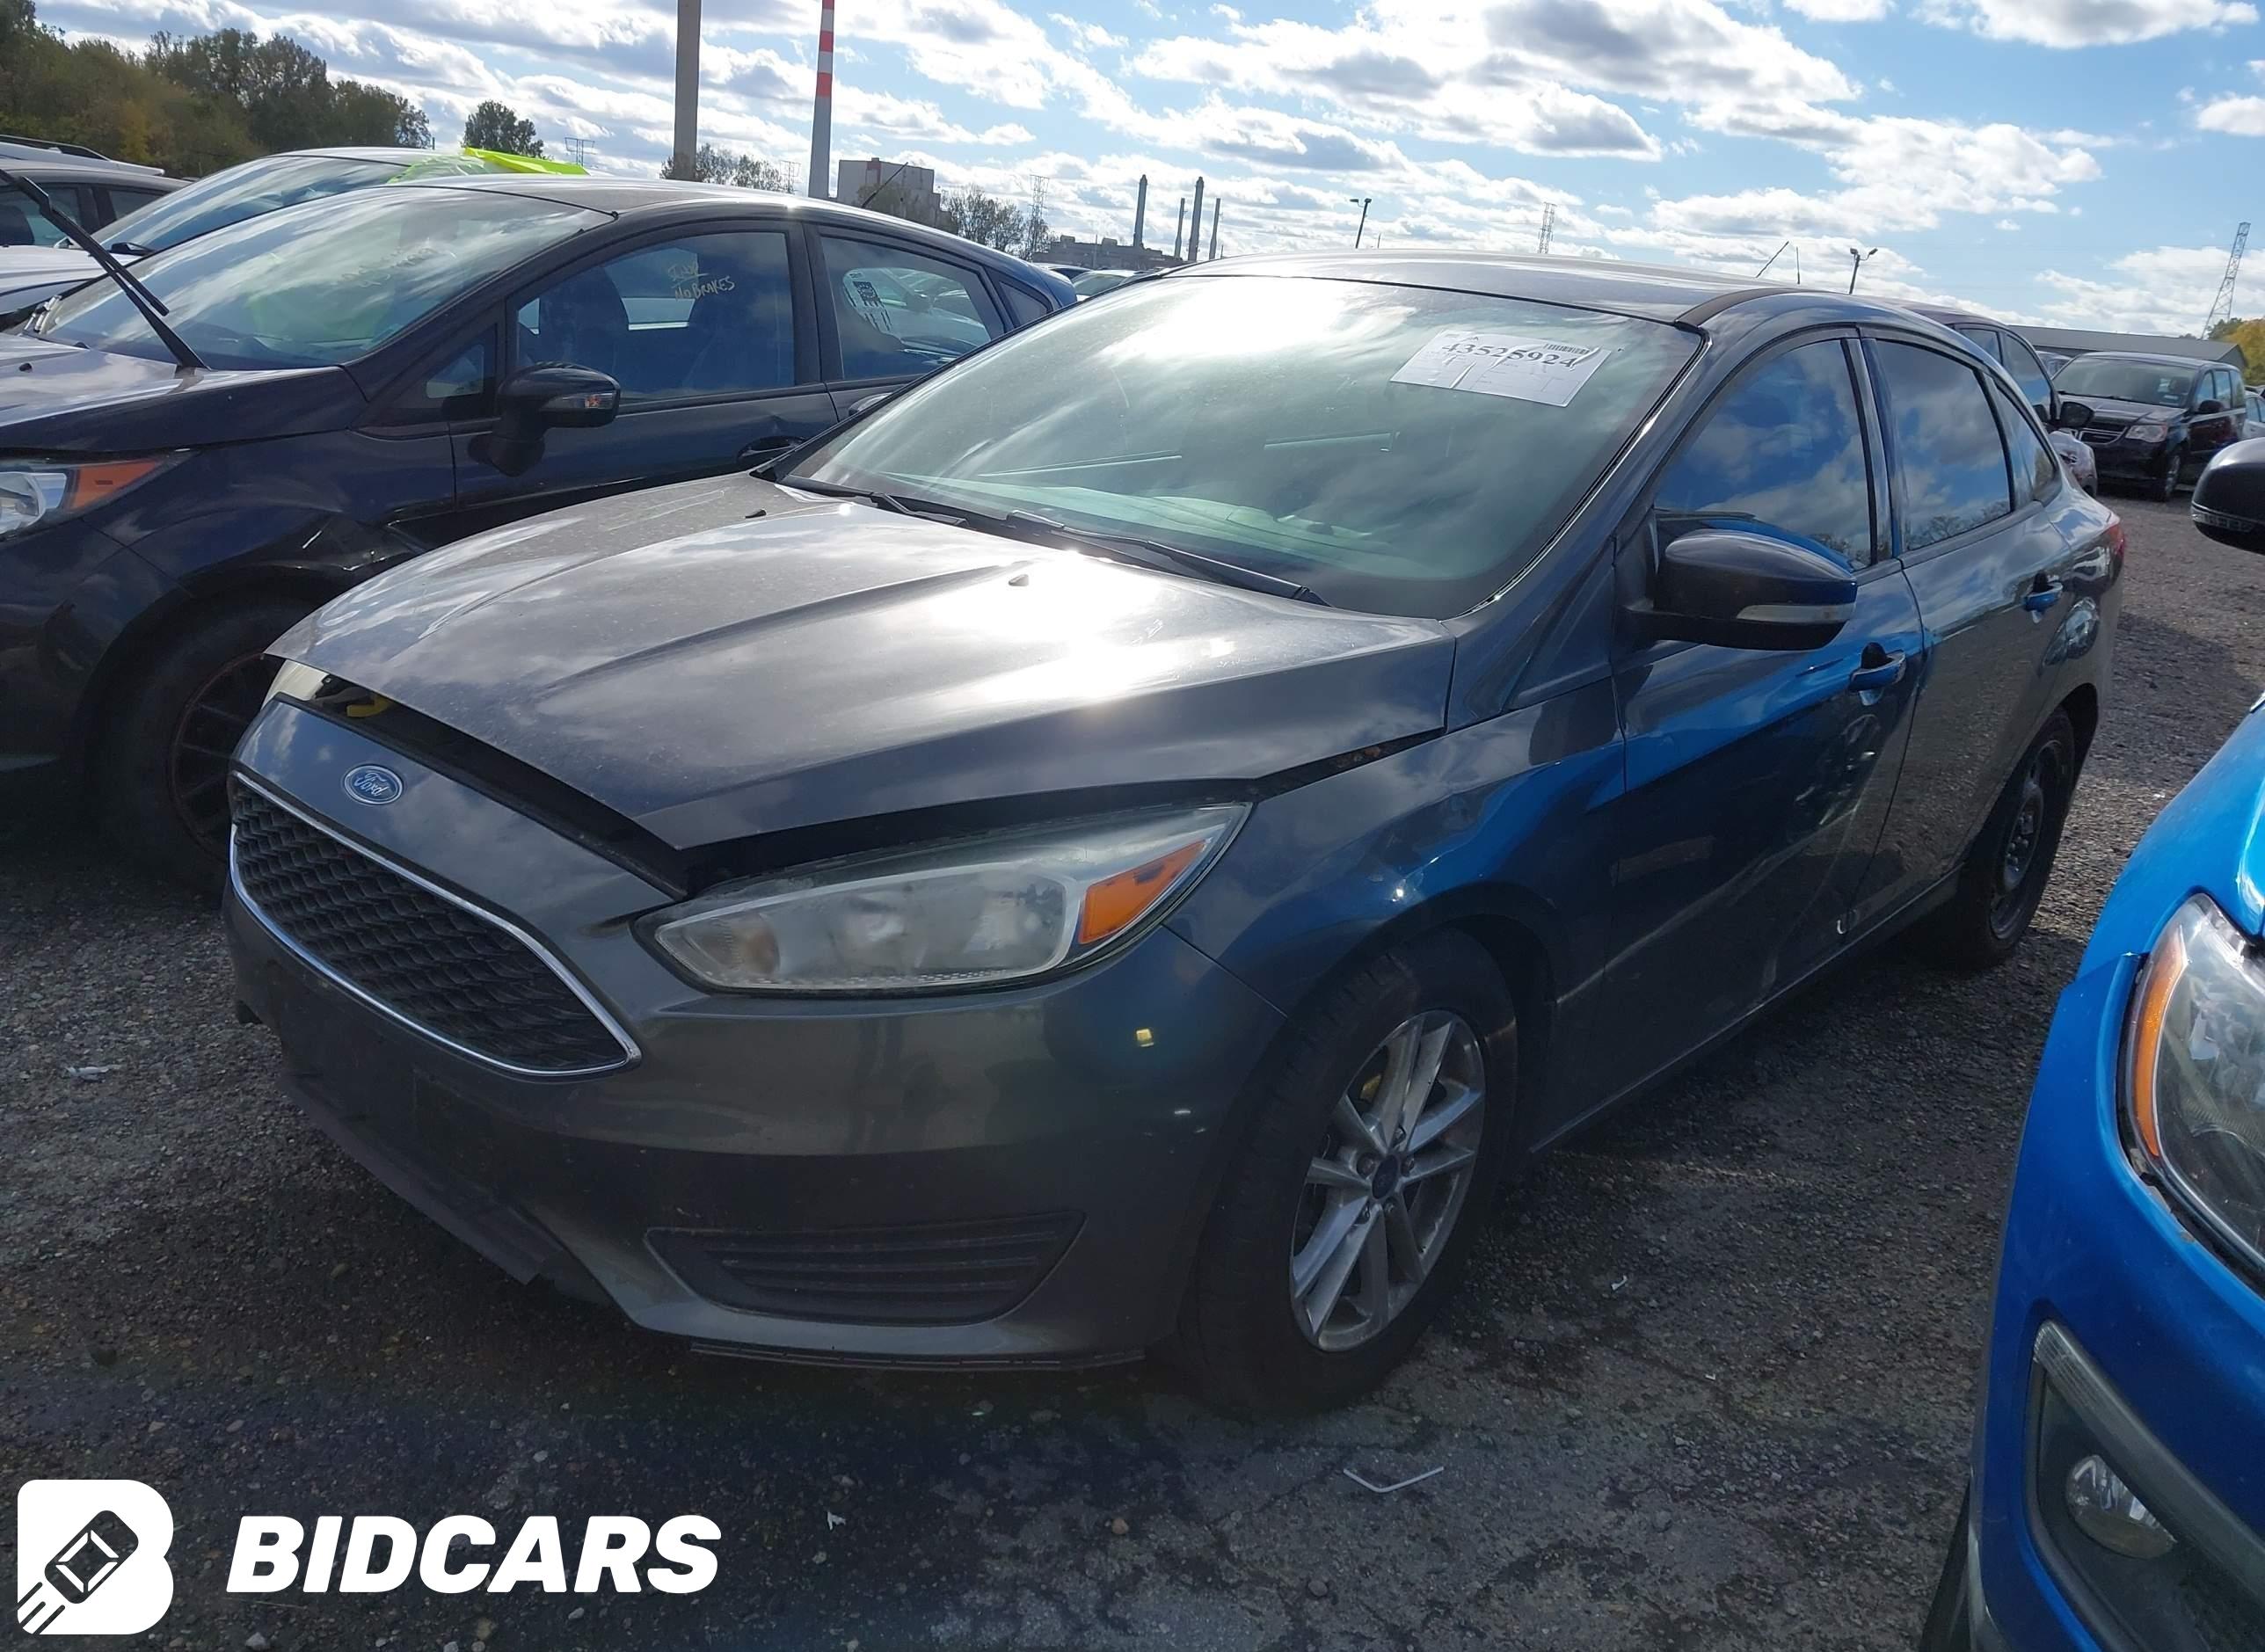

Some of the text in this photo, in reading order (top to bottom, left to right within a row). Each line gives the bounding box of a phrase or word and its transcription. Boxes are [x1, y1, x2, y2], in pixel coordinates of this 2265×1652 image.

[692, 276, 736, 300] BRAKES
[1441, 342, 1577, 368] 43525924
[354, 773, 390, 796] Ford
